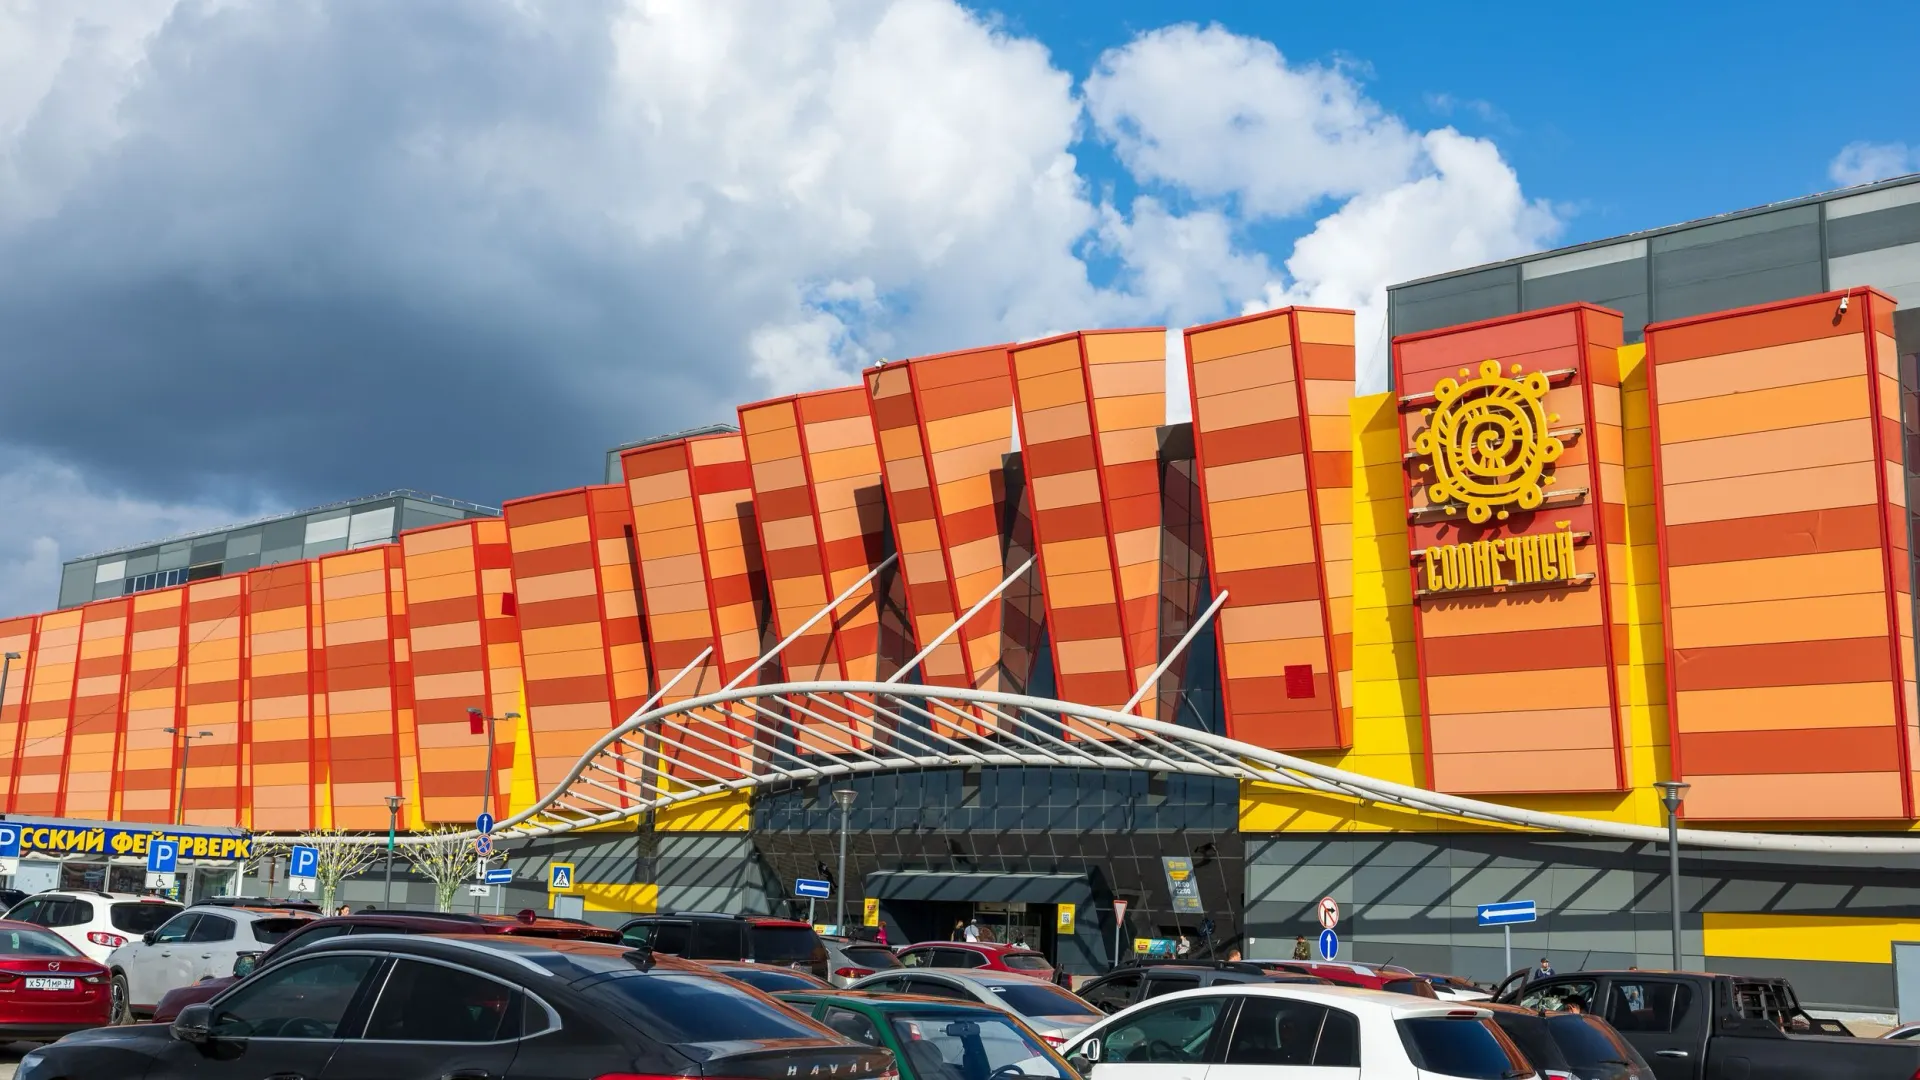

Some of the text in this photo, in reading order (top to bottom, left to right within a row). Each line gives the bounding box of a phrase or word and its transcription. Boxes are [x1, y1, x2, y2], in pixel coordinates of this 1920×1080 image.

[1426, 520, 1576, 591] СОЛНЕЧНЫЙ
[21, 827, 251, 858] ССКИЙ ФЕЙРВЕРК
[156, 845, 173, 869] P
[298, 850, 314, 874] P
[787, 1062, 872, 1076] HAVAL
